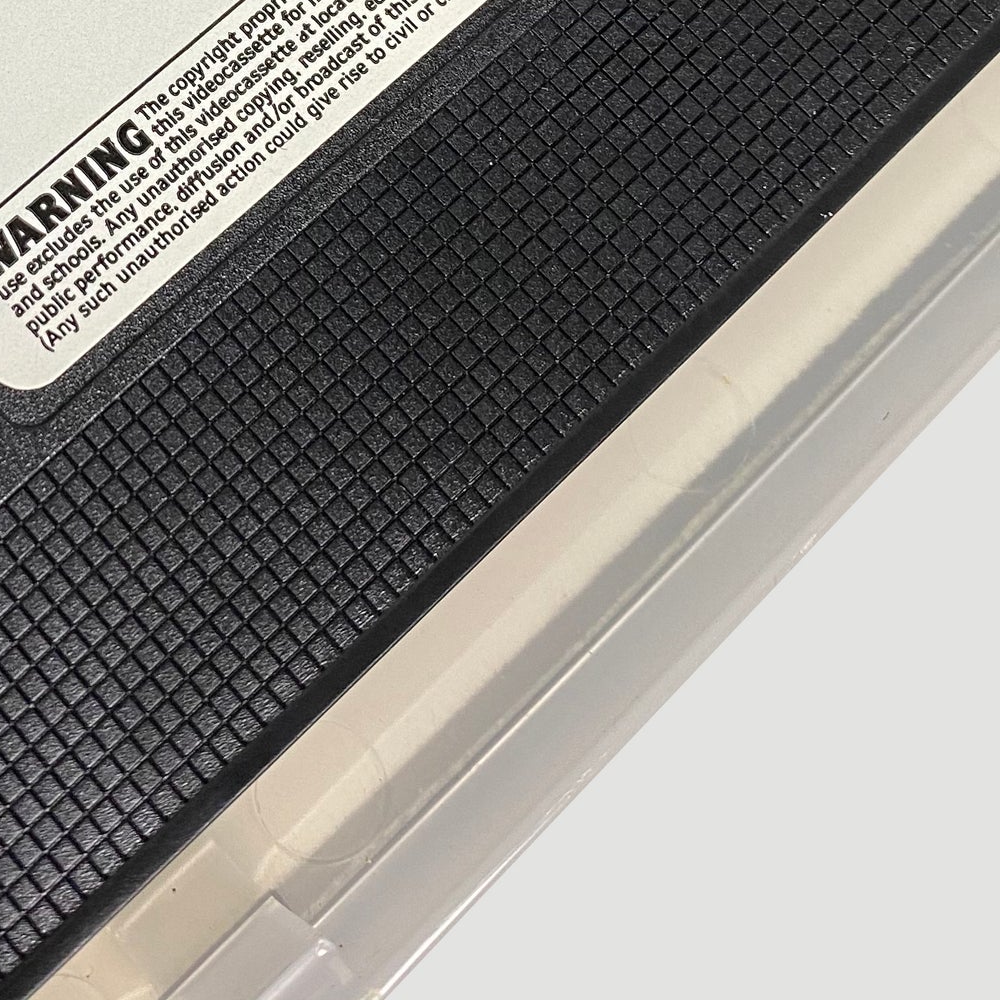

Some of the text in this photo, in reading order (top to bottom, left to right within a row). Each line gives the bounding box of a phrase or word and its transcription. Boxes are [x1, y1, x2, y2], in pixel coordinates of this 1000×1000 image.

[24, 286, 77, 339] public
[175, 140, 247, 204] diffusion
[242, 93, 297, 146] and/or
[291, 31, 372, 100] broadcast
[366, 12, 388, 38] of
[25, 213, 95, 277] excludes
[89, 189, 123, 219] the
[117, 165, 151, 195] use
[147, 145, 168, 171] of
[162, 123, 199, 155] this
[193, 38, 299, 128] videocassette
[294, 21, 318, 44] at
[38, 312, 81, 354] (Any
[77, 280, 119, 319] such
[114, 188, 220, 285] unauthorised
[214, 150, 268, 198] action
[263, 110, 310, 156] could
[305, 85, 342, 122] give
[336, 61, 370, 92] rise
[364, 46, 388, 66] to
[383, 15, 420, 51] civil
[415, 1, 436, 24] or
[133, 92, 171, 122] The
[167, 30, 244, 98] copyright
[150, 106, 186, 138] this
[180, 21, 286, 111] videocassette
[279, 0, 308, 28] for
[9, 282, 46, 319] and
[41, 234, 108, 292] schools.
[103, 202, 140, 238] Any
[135, 115, 239, 208] unauthorised
